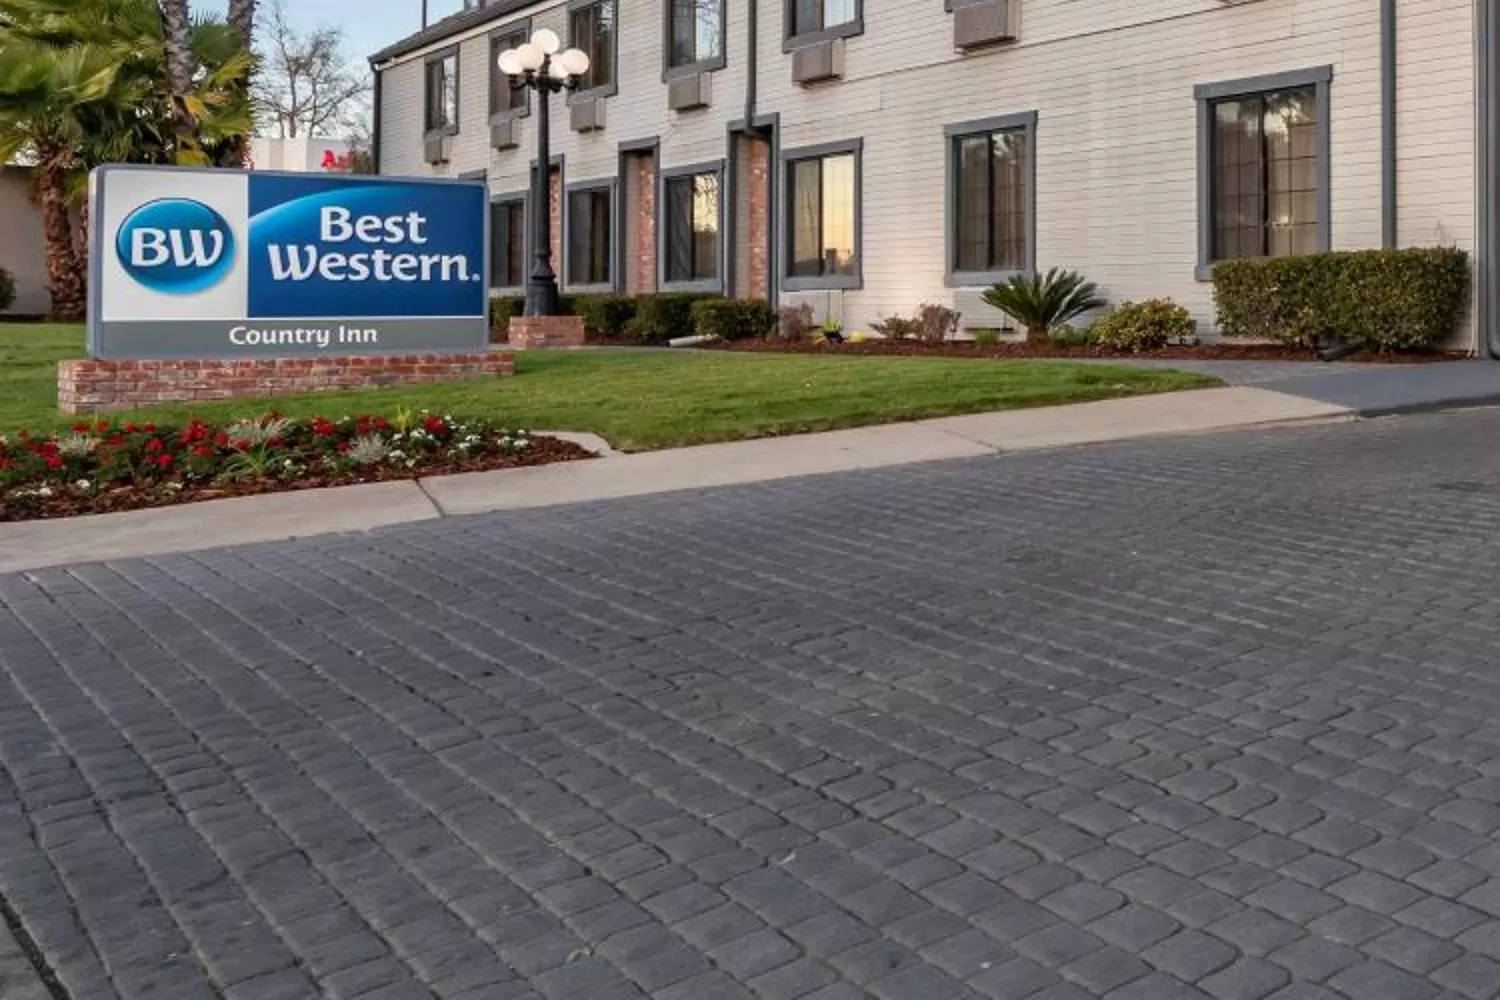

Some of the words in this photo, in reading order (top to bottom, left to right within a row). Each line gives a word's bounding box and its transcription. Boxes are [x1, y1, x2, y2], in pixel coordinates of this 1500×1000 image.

[319, 205, 427, 242] Best
[131, 227, 223, 267] BW
[229, 326, 329, 346] Country
[338, 326, 378, 343] Inn
